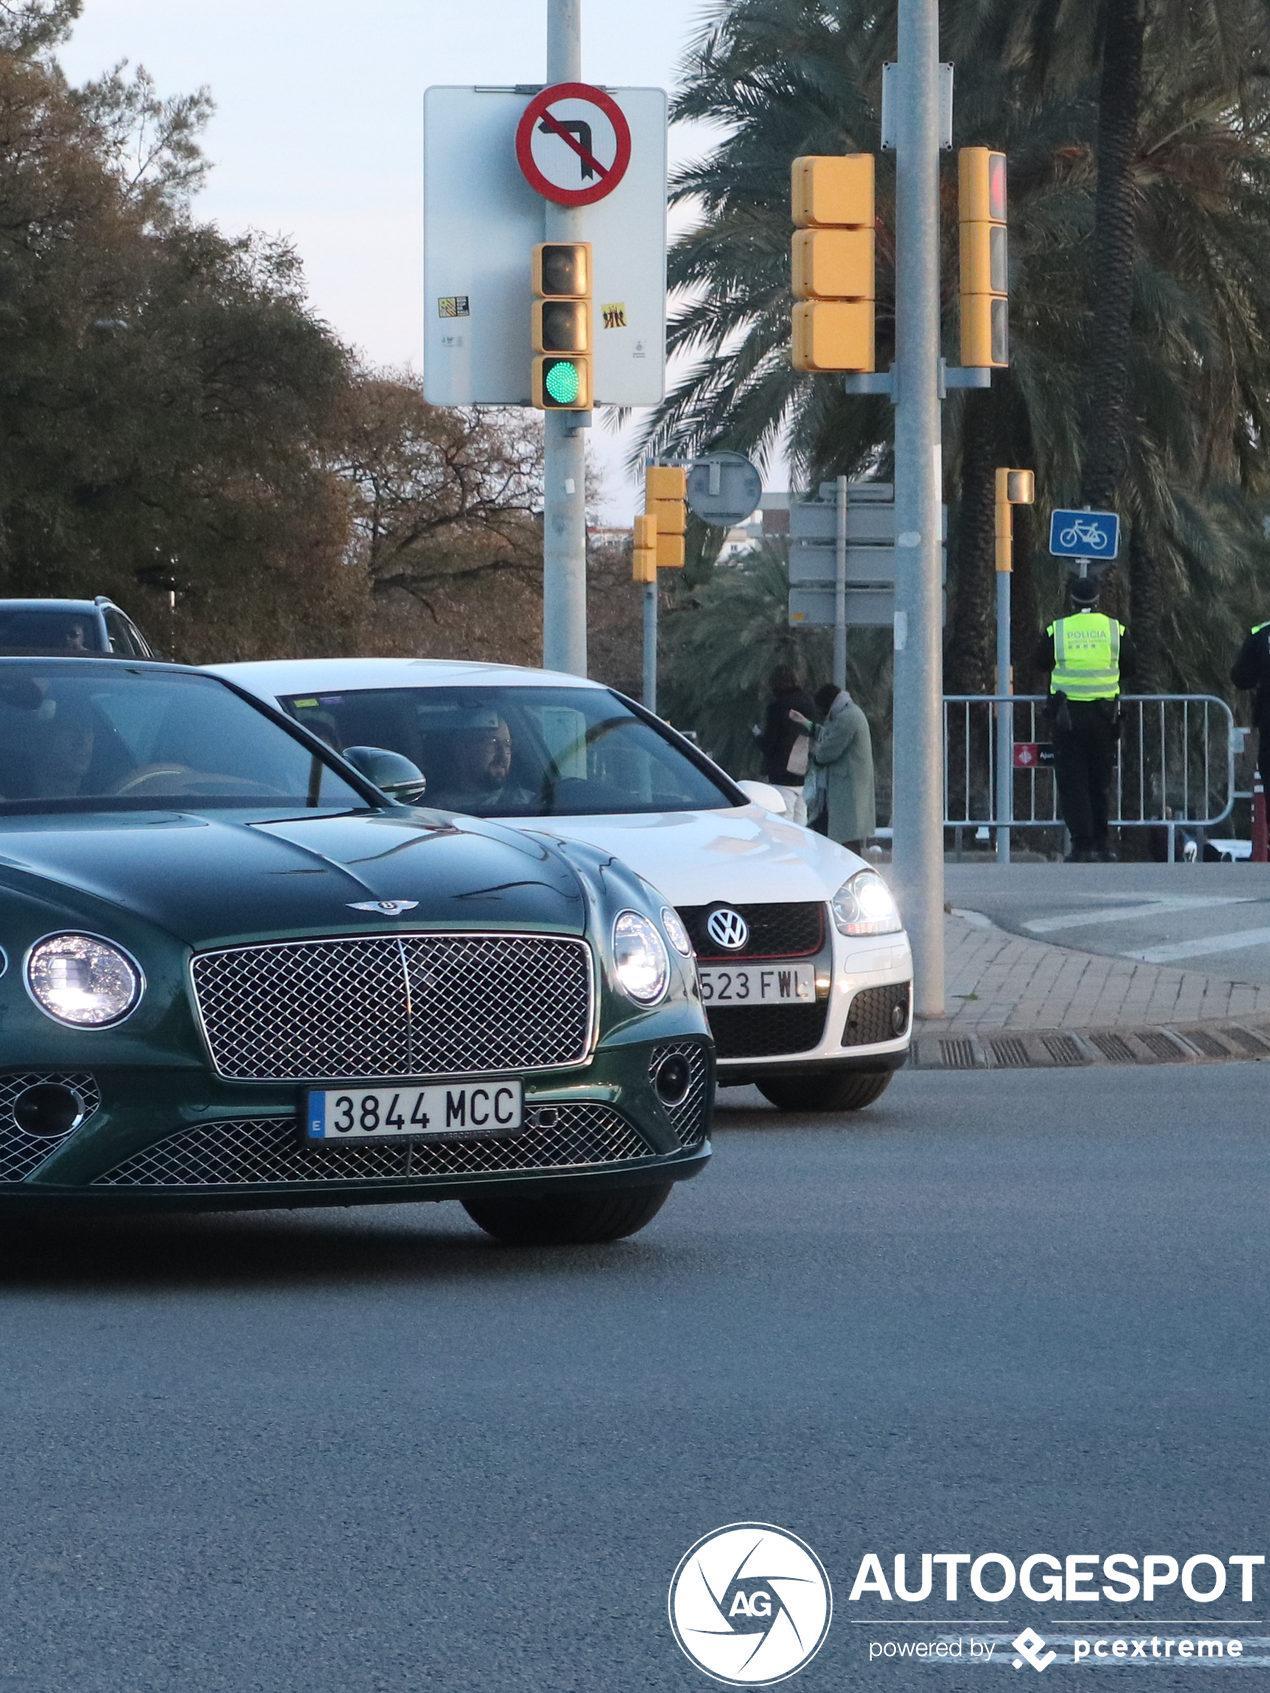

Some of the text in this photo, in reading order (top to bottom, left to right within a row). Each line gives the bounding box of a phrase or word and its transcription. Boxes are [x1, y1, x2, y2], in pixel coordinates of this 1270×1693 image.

[312, 1087, 515, 1132] E 3844 MCC
